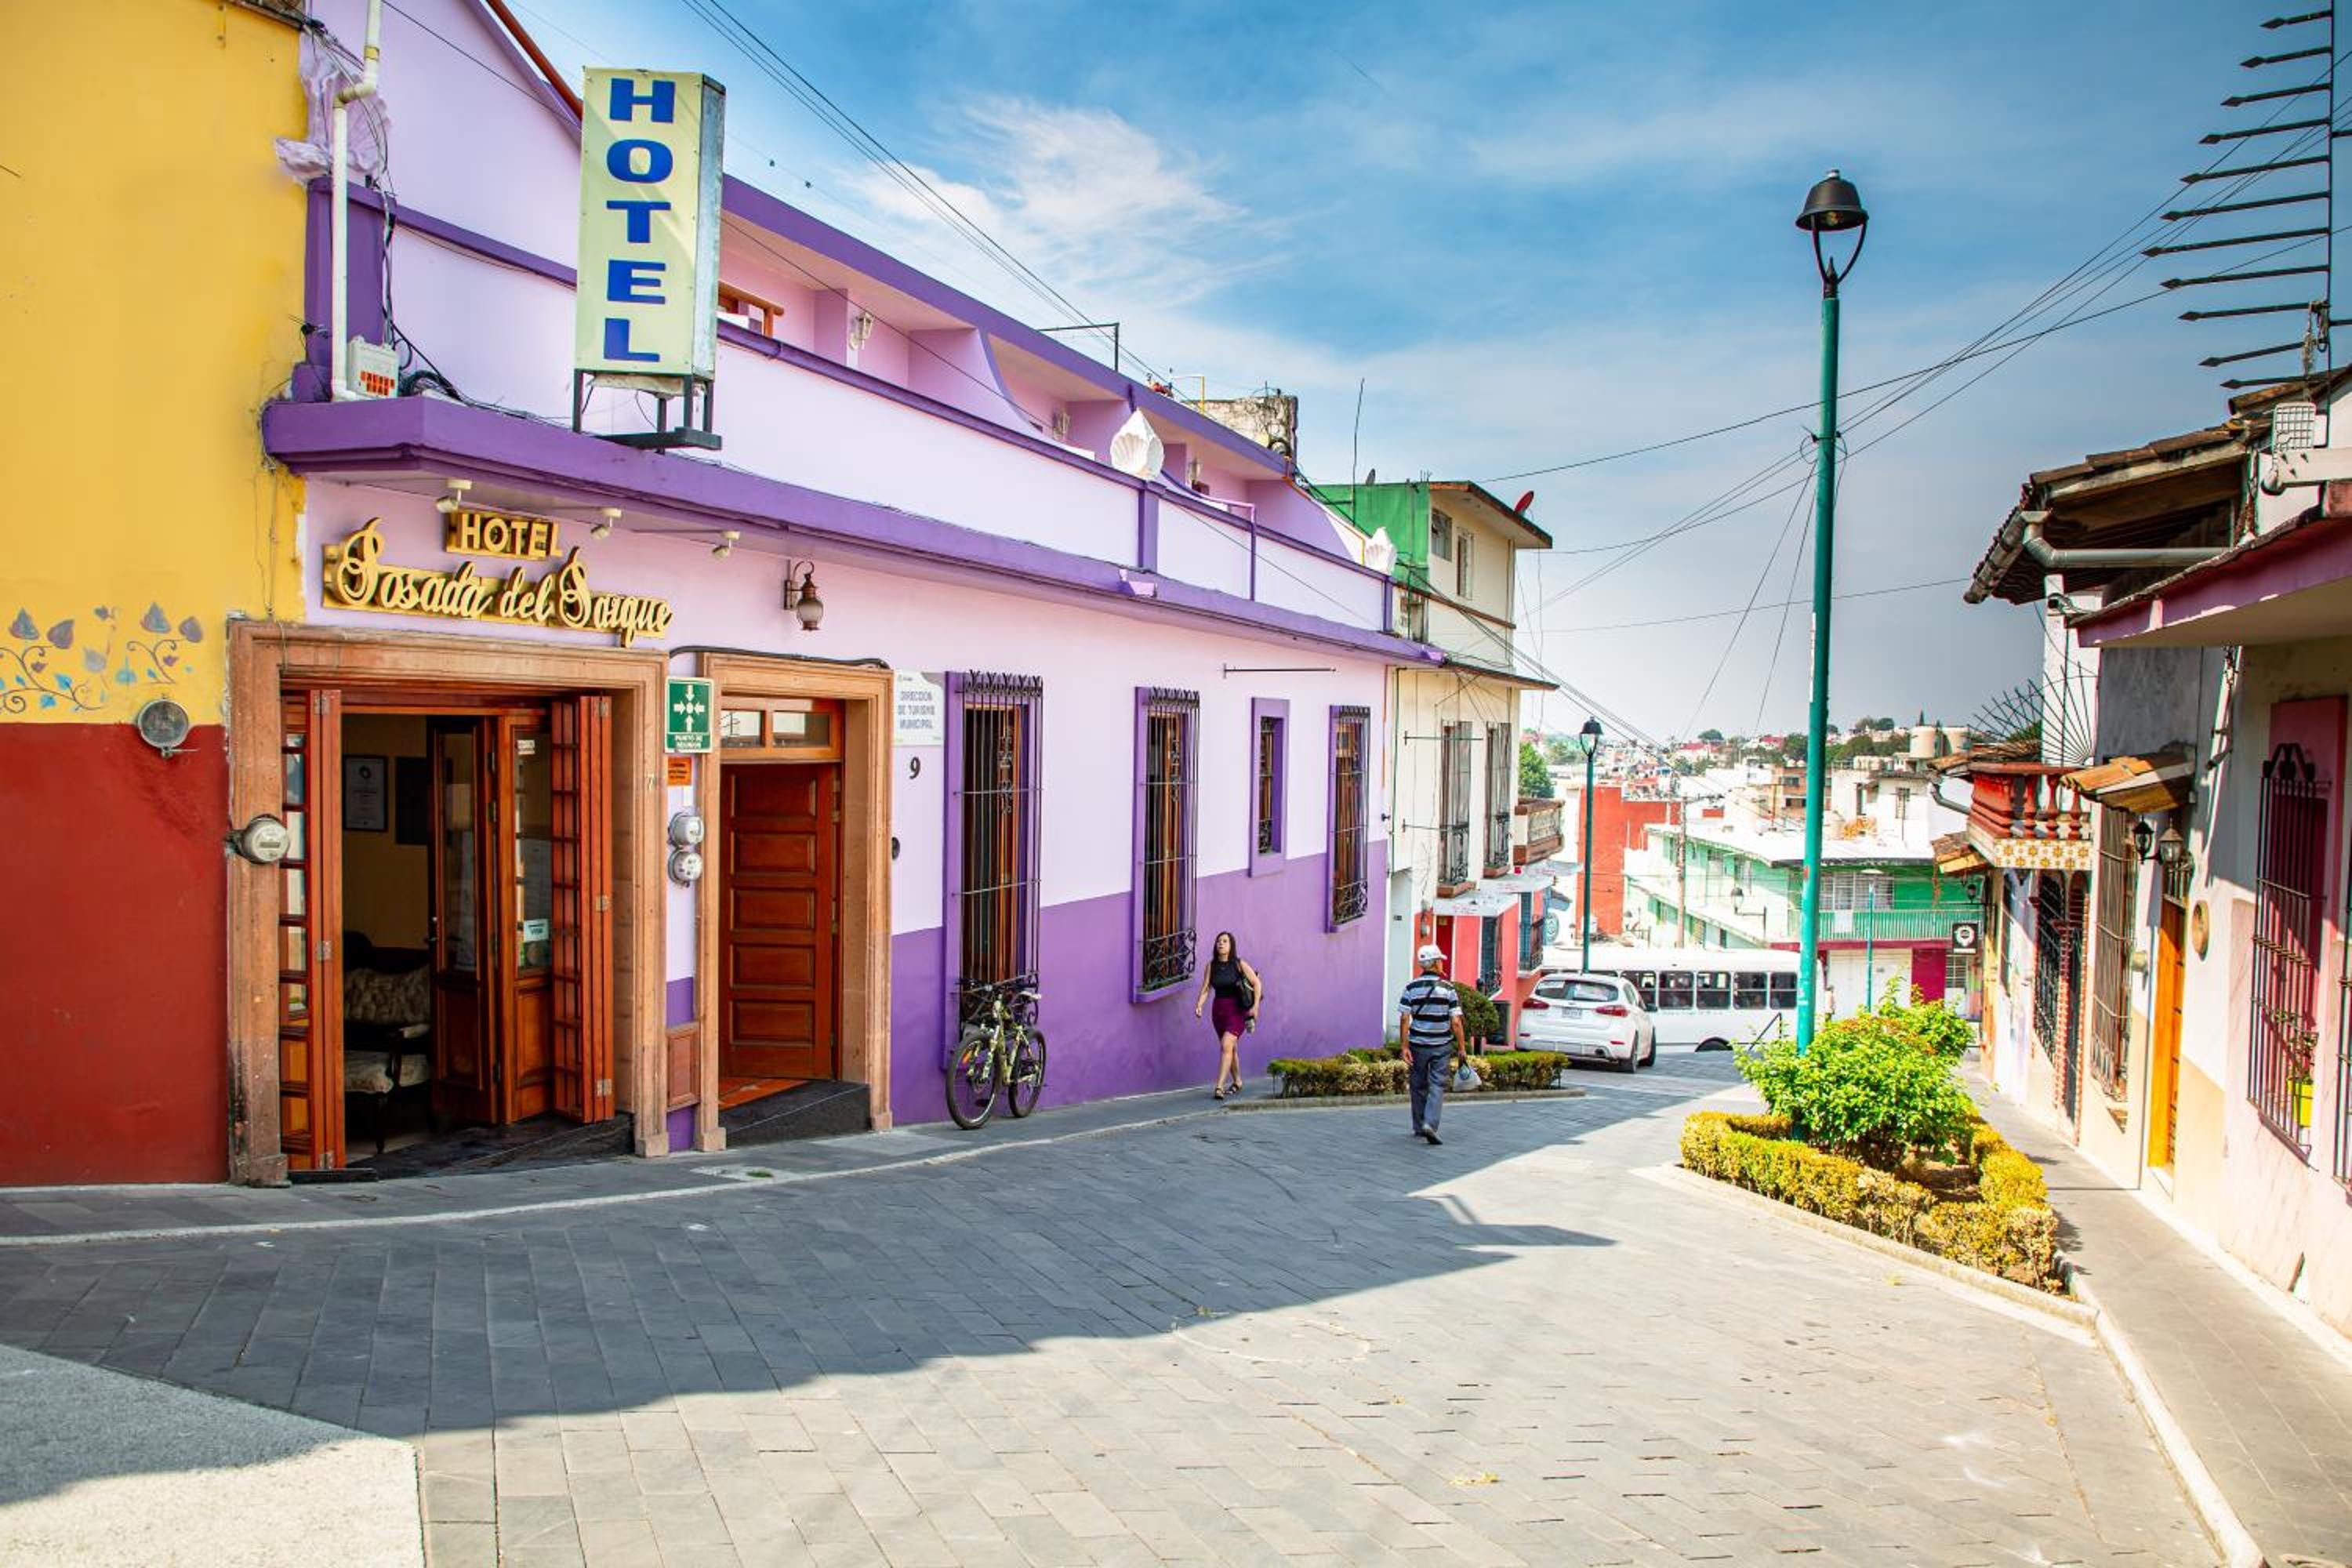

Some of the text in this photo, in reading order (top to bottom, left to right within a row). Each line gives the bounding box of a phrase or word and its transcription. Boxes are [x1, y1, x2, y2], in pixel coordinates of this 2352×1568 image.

[603, 78, 676, 362] HOTEL
[461, 514, 563, 559] HOTEL
[337, 517, 493, 619] Posada
[499, 568, 554, 622] del
[898, 705, 935, 715] DE TURISMO
[899, 719, 933, 729] MUNICIPAL
[909, 757, 921, 779] 9
